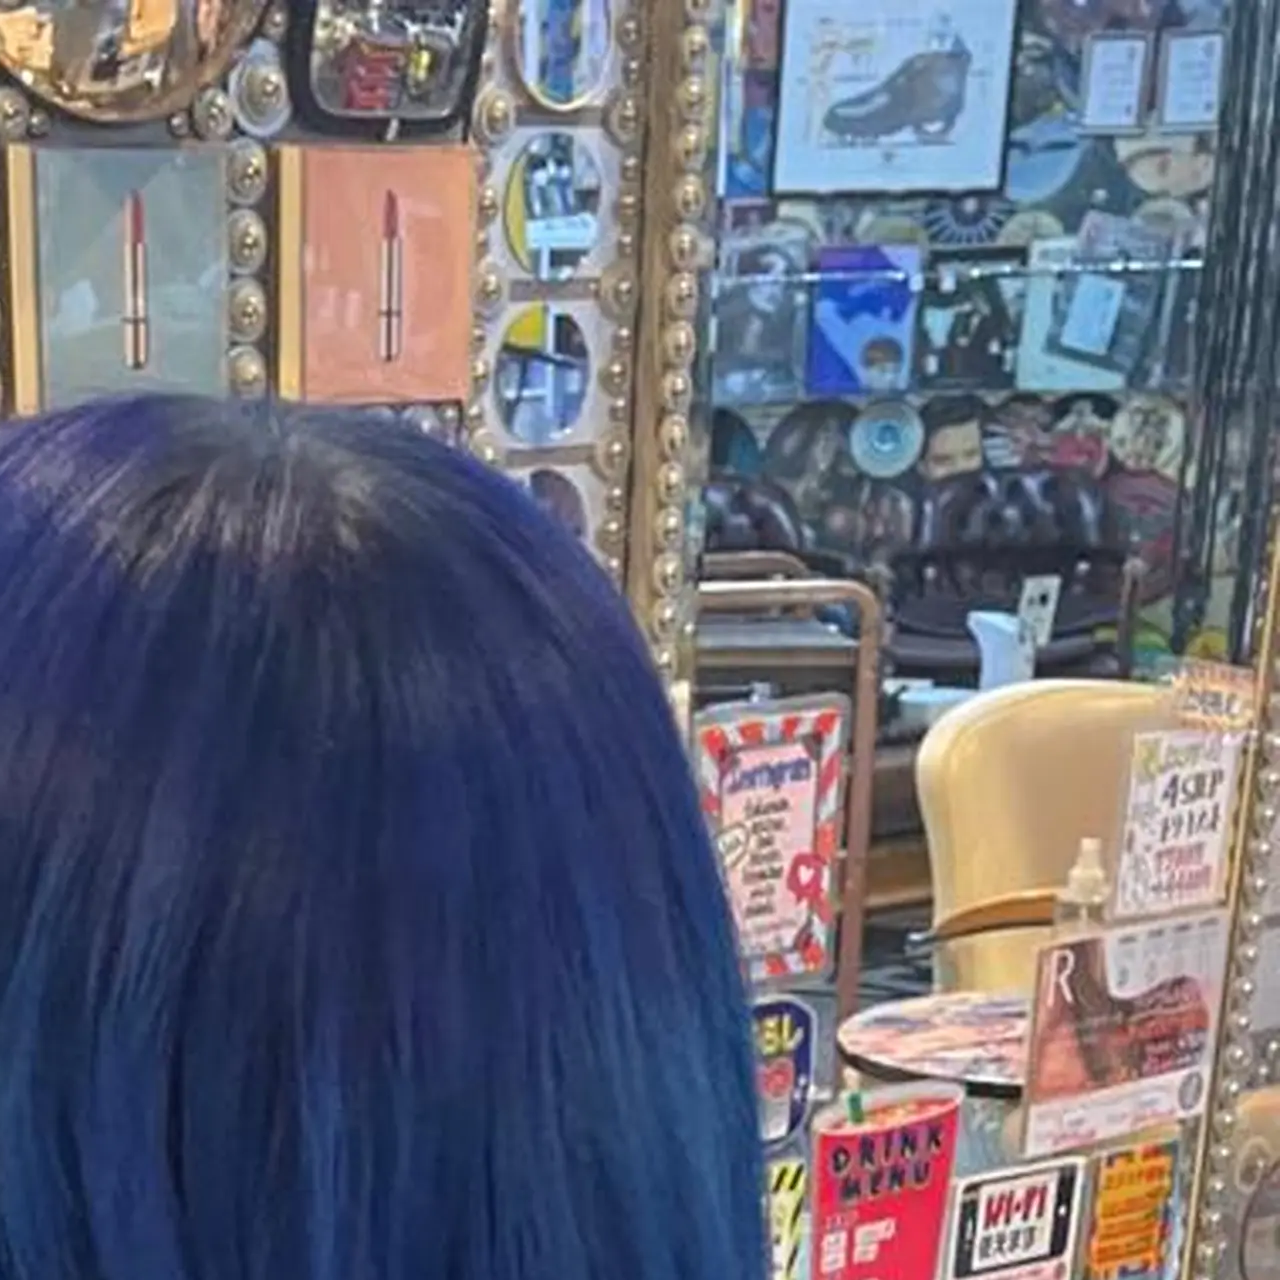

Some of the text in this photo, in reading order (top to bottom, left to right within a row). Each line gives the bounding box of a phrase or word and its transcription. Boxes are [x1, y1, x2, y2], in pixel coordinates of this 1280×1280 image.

[1047, 948, 1074, 1008] R
[831, 1127, 942, 1174] DRINK
[842, 1160, 930, 1202] MENU
